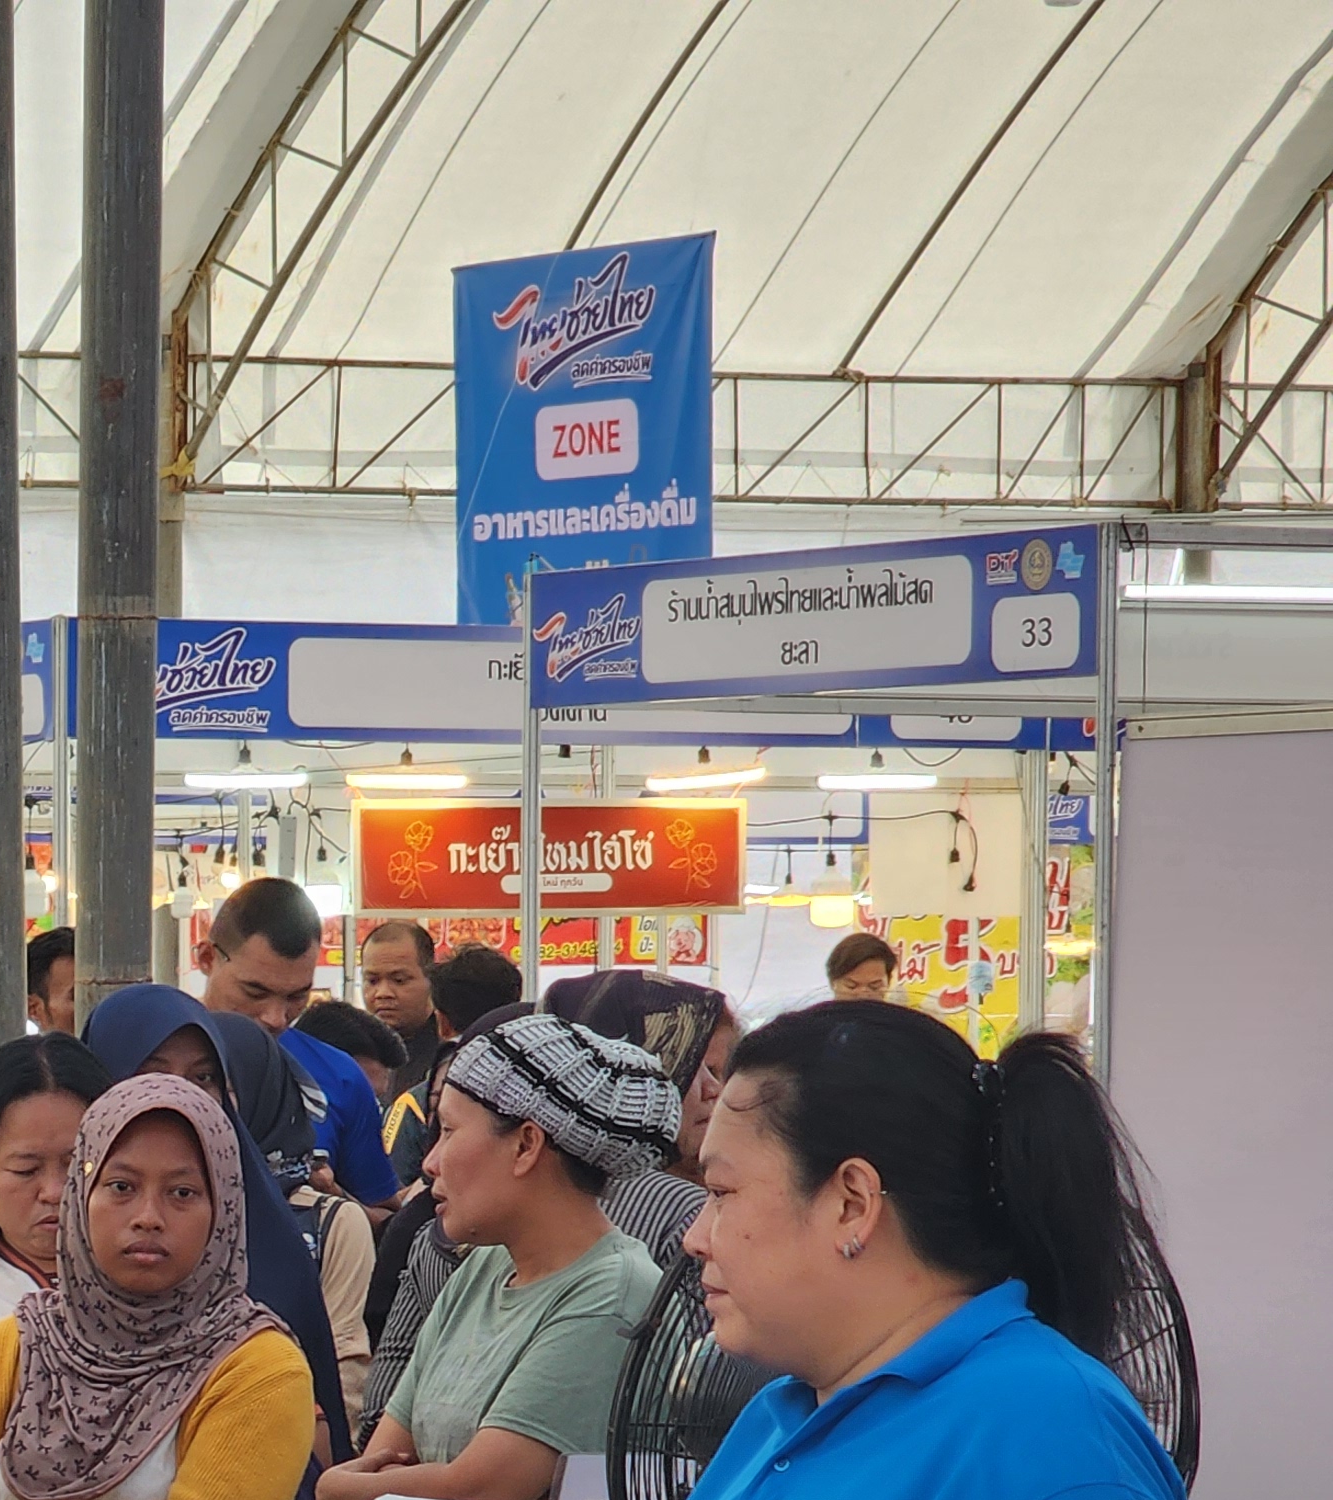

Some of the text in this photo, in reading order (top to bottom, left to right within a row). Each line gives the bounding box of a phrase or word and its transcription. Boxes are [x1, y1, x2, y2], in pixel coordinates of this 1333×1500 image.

[552, 418, 621, 459] ZONE
[472, 477, 698, 542] อาหารและเครื่องดื่ม
[1020, 616, 1053, 648] 33
[155, 627, 276, 694] ช่วยไทย
[780, 639, 820, 666] ยะลา
[169, 704, 271, 726] ลดค่าครองชีพ
